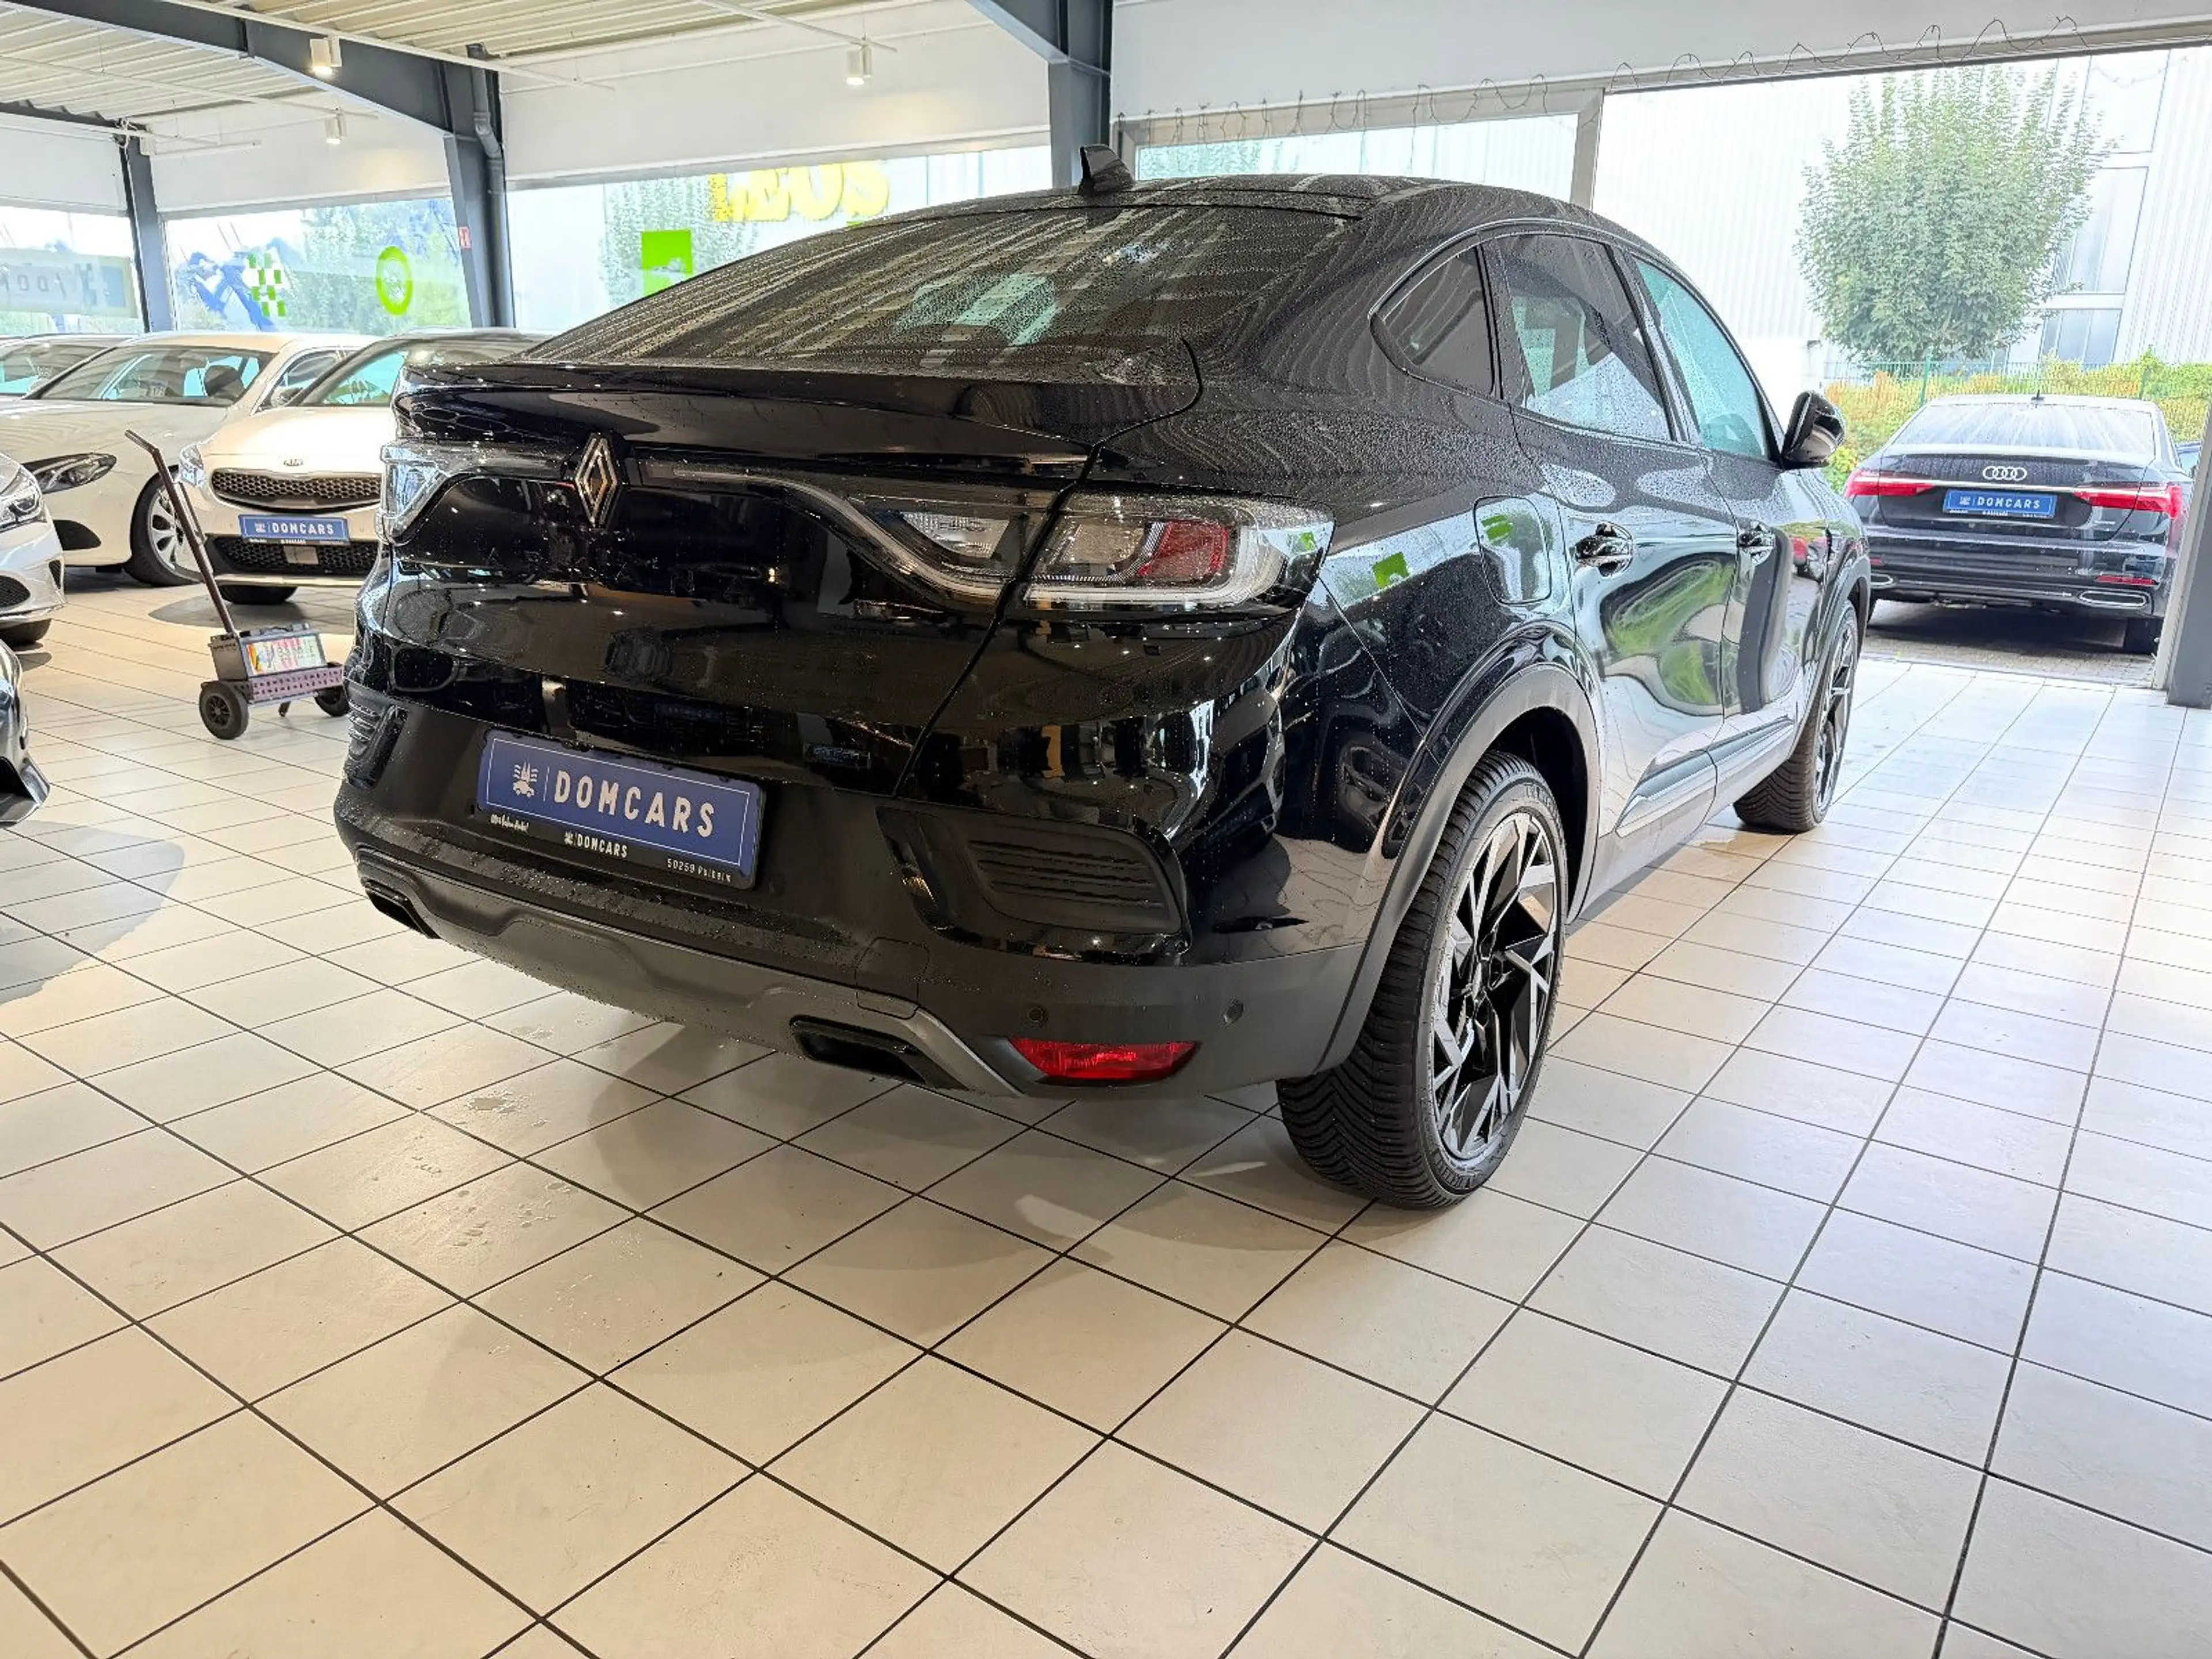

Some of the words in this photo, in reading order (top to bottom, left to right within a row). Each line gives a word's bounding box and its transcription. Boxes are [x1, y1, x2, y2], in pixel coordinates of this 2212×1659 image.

[1977, 496, 2040, 509] DOMCARS
[272, 522, 334, 535] DOMCARS
[554, 770, 715, 838] DOMCARS
[577, 833, 627, 858] DOMCARS
[667, 858, 695, 873] 50259
